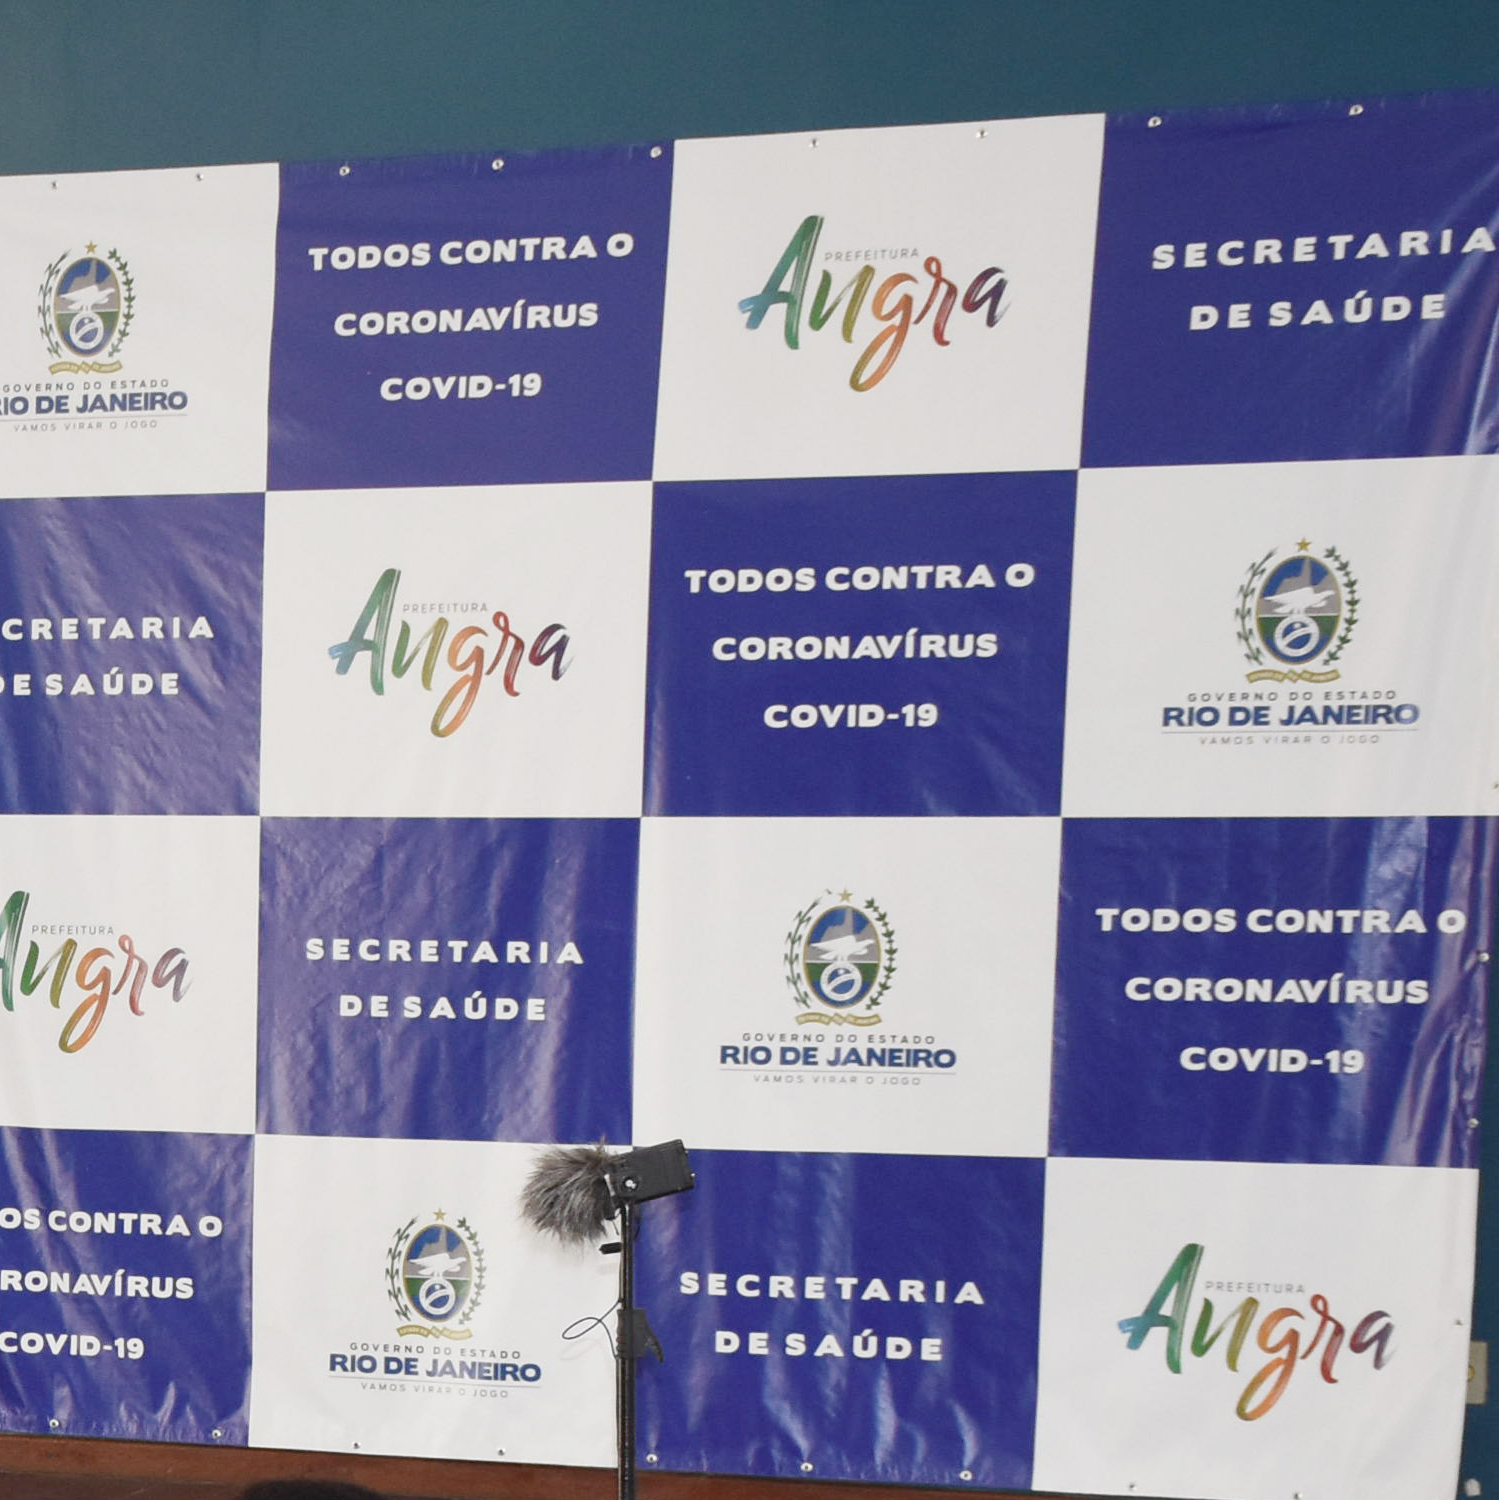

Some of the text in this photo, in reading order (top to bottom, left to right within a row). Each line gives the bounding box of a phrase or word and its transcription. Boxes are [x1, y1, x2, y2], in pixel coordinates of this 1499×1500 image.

[308, 232, 634, 271] TODOS CONTRA O
[824, 248, 919, 262] PREFEITURA
[1152, 226, 1496, 270] SECRETARIA
[737, 214, 1012, 392] Angra
[1189, 289, 1447, 331] DE SAÚDE
[333, 299, 599, 337] CORONAVÍRUS
[2, 379, 169, 393] GOVERNO DO ESTADO
[380, 372, 542, 401] COVID-19
[35, 395, 70, 414] DE
[76, 391, 188, 414] JANEIRO
[14, 423, 57, 432] VAMOS
[684, 562, 1035, 594] TODOS CONTRA O
[403, 603, 488, 614] PREFEITURA
[328, 568, 575, 738] Angra
[712, 627, 998, 661] CORONAVÍRUS
[45, 666, 179, 696] SAÚDE
[1187, 690, 1396, 703] GOVERNO DO ESTADO
[763, 703, 938, 729] COVID-19
[1162, 703, 1419, 727] RIO DE JANEIRO
[1200, 735, 1254, 745] VAMOS
[31, 924, 115, 935] PREFEITURA
[1095, 907, 1467, 936] TODOS CONTRA O
[305, 937, 584, 965] SECRETARIA
[1125, 972, 1429, 1007] CORONAVÍRUS
[339, 990, 546, 1021] DE SAÚDE
[742, 1032, 935, 1045] GOVERNO DO ESTADO
[720, 1045, 957, 1069] RIO DE JANEIRO
[1180, 1046, 1366, 1074] COVID-19
[754, 1075, 804, 1084] VAMOS
[48, 1209, 191, 1237] CONTRA
[198, 1215, 223, 1238] O
[679, 1271, 985, 1305] SECRETARIA
[1205, 1281, 1305, 1294] PREFEITURA
[714, 1328, 943, 1362] DE SAÚDE
[1117, 1243, 1396, 1422] Angra
[349, 1342, 521, 1360] GOVERNO DO ESTADO
[329, 1353, 542, 1383] RIO DE JANEIRO
[361, 1382, 406, 1392] VAMOS
